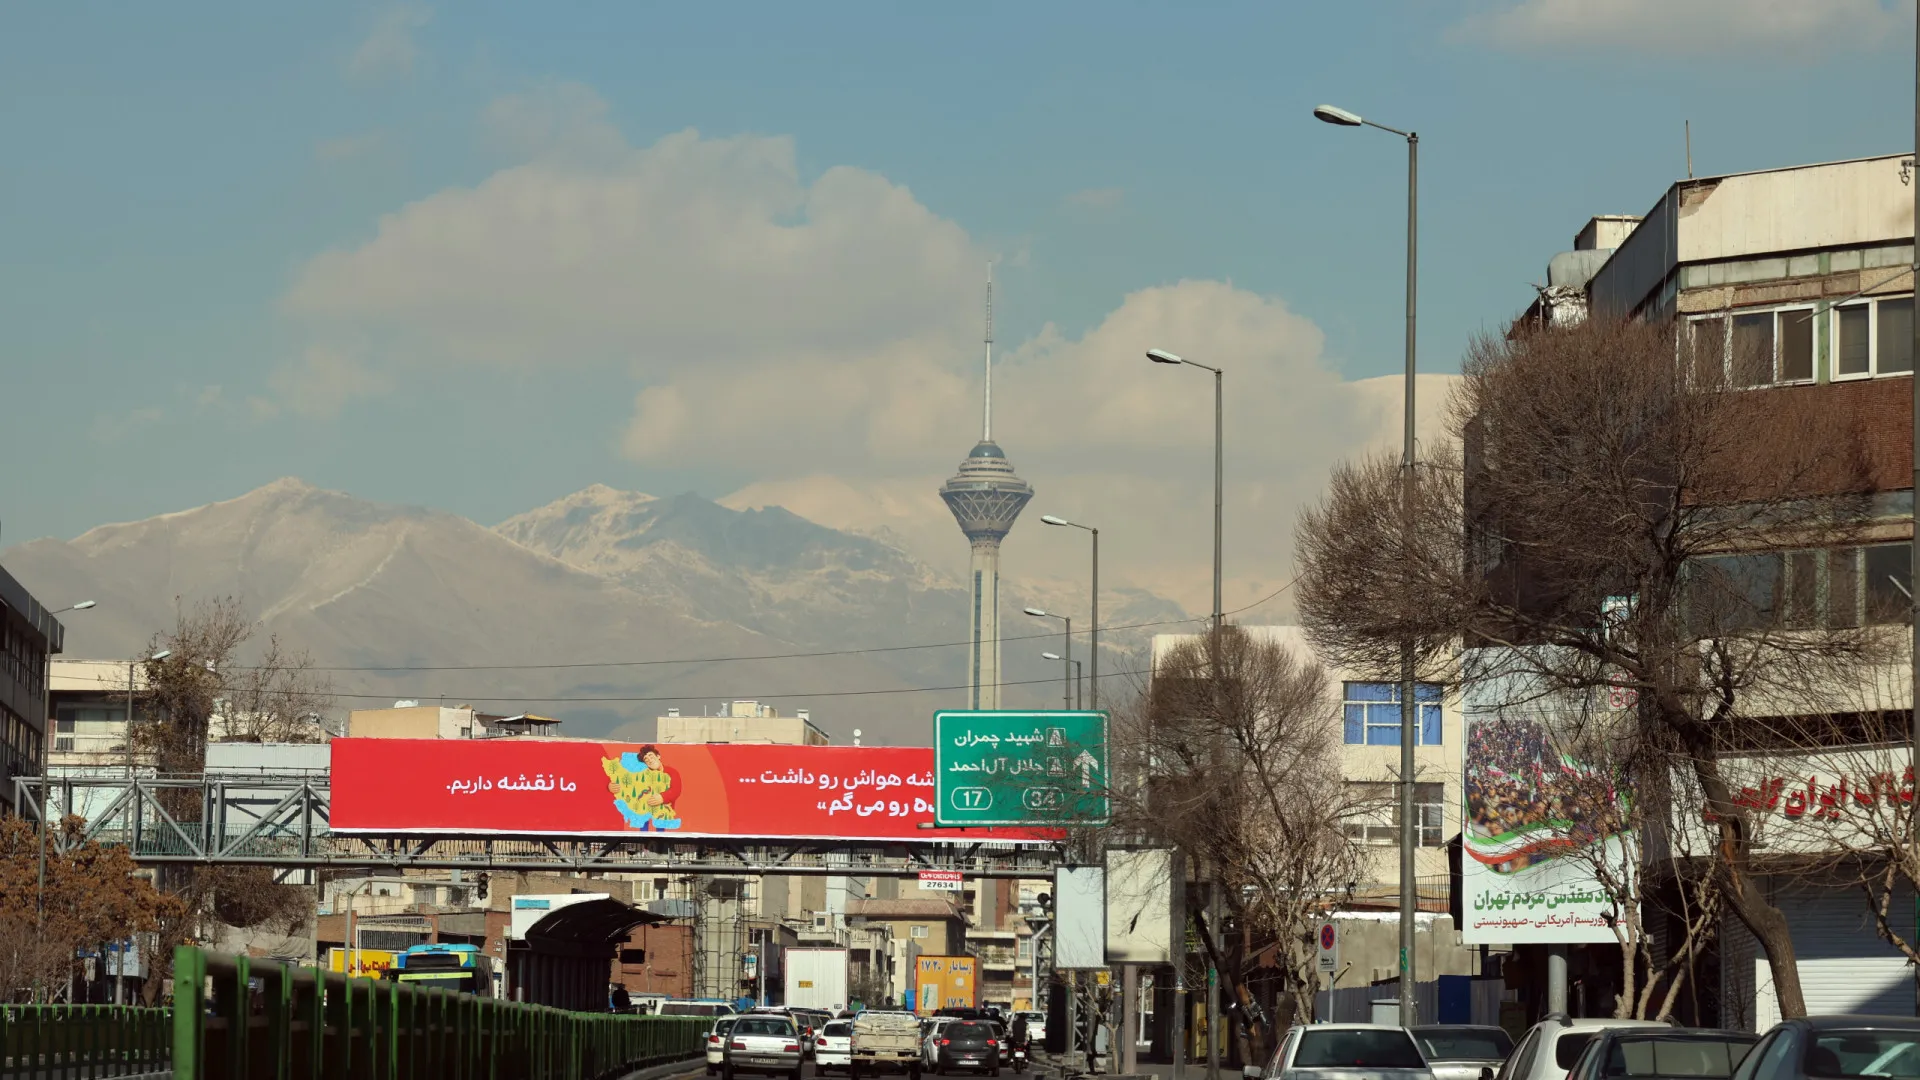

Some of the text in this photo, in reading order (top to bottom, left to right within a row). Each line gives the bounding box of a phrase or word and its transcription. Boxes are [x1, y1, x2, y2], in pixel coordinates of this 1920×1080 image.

[954, 728, 1044, 749] شهید چمران
[446, 774, 577, 794] ما نقشه داریم.
[760, 768, 815, 785] داشت
[819, 776, 839, 790] رو
[843, 769, 902, 790] هواش
[962, 790, 983, 807] 17
[1030, 791, 1055, 807] 34
[1784, 773, 1848, 819] ایران
[888, 802, 909, 816] رو
[926, 881, 954, 889] 27634
[1474, 889, 1510, 911] تهران
[1511, 891, 1545, 910] مردم
[1473, 917, 1528, 929] صهیونیستی
